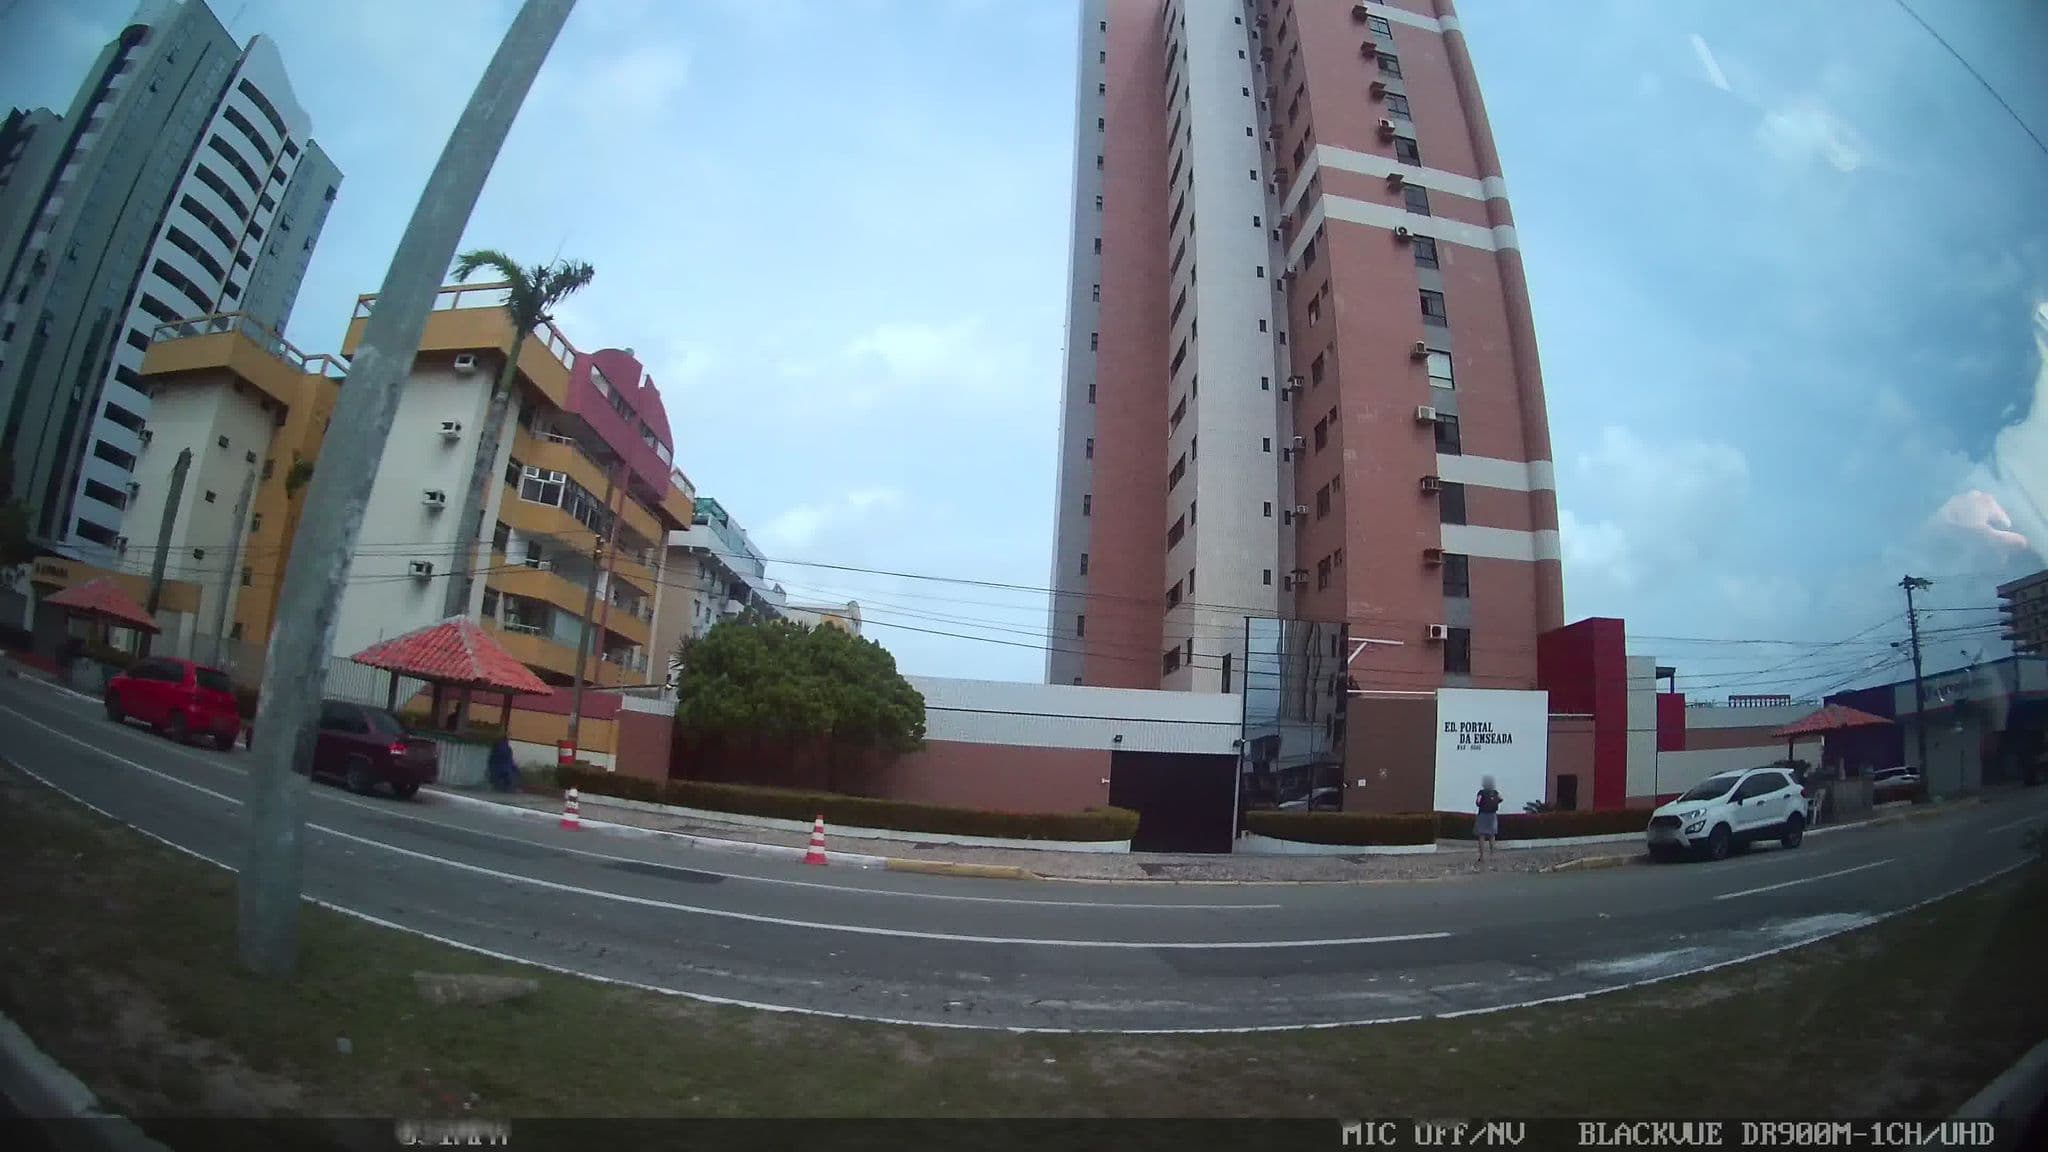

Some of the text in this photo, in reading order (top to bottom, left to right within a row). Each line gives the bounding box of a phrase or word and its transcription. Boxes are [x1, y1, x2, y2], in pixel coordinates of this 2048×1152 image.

[1460, 721, 1493, 732] PORTAL
[1460, 733, 1513, 744] DA ENSEADA
